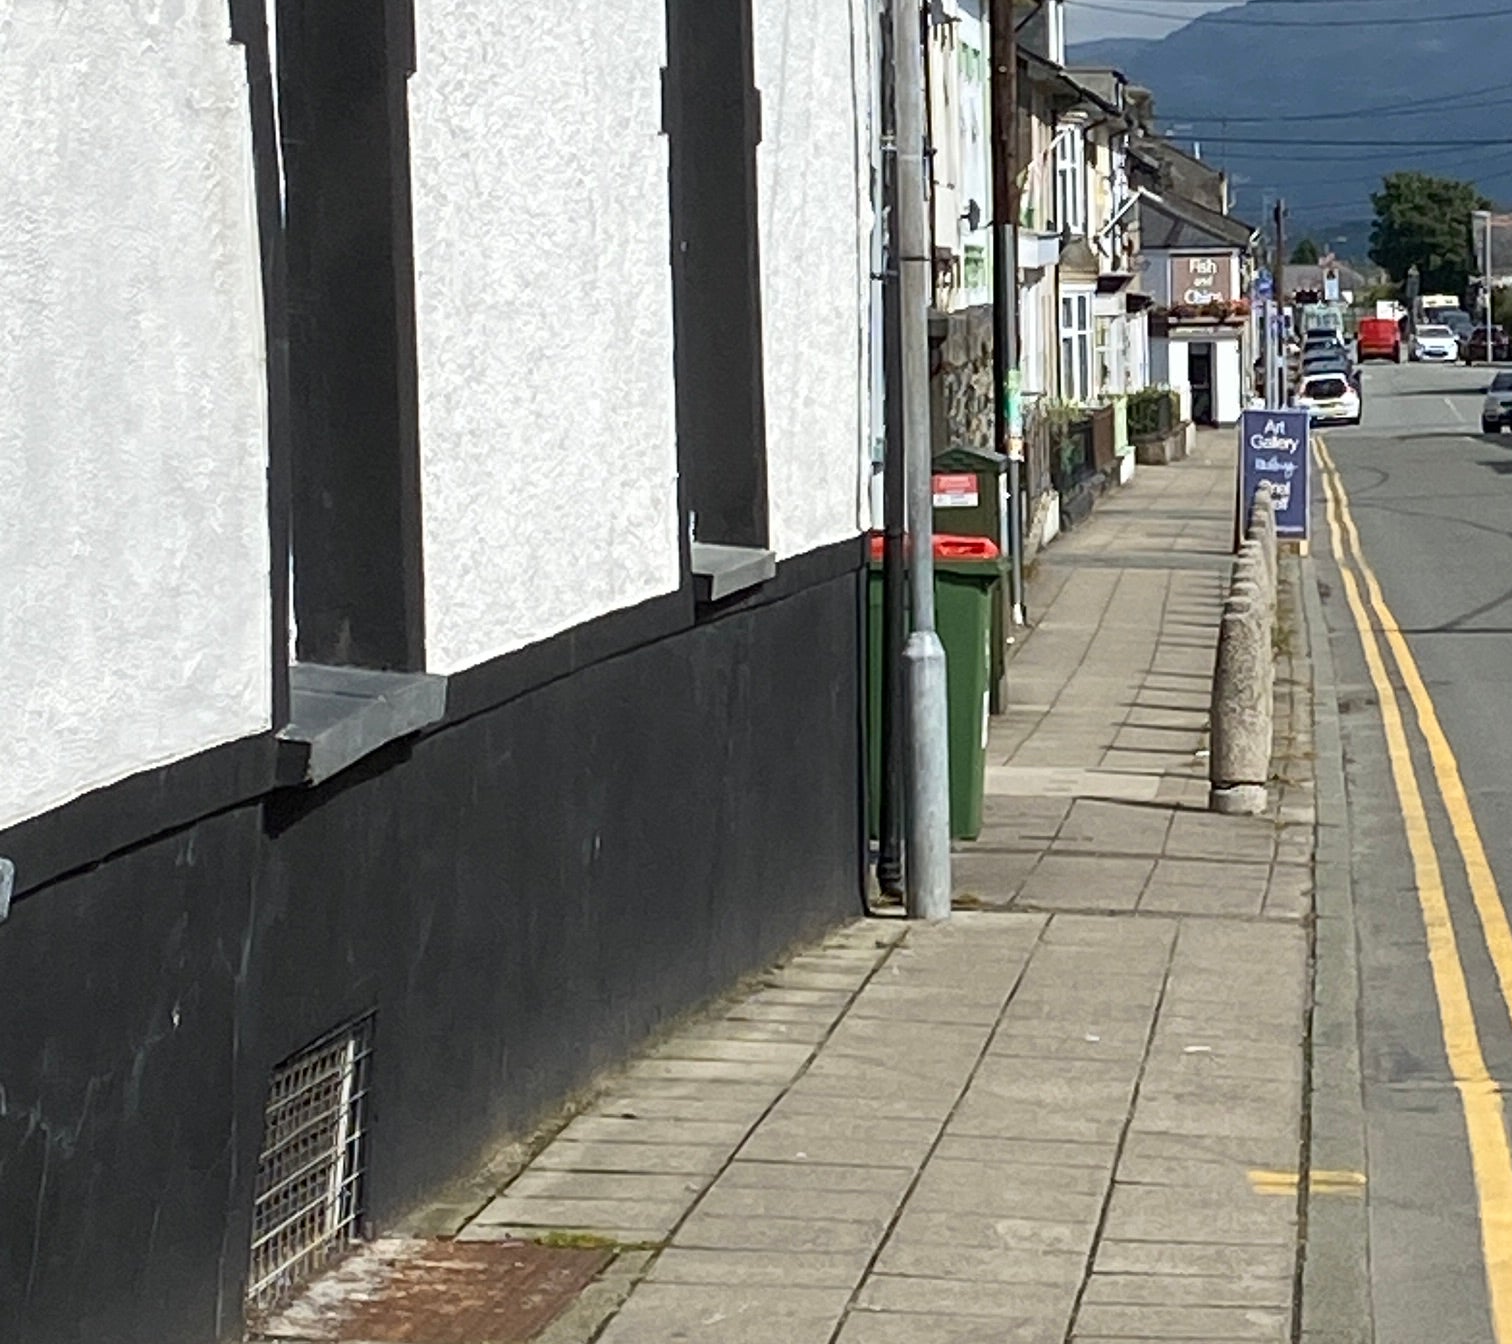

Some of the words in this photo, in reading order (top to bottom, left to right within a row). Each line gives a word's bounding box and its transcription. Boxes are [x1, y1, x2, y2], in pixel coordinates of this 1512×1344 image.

[1189, 258, 1217, 273] Fish
[1264, 418, 1286, 435] Art
[1250, 434, 1300, 454] Gallery
